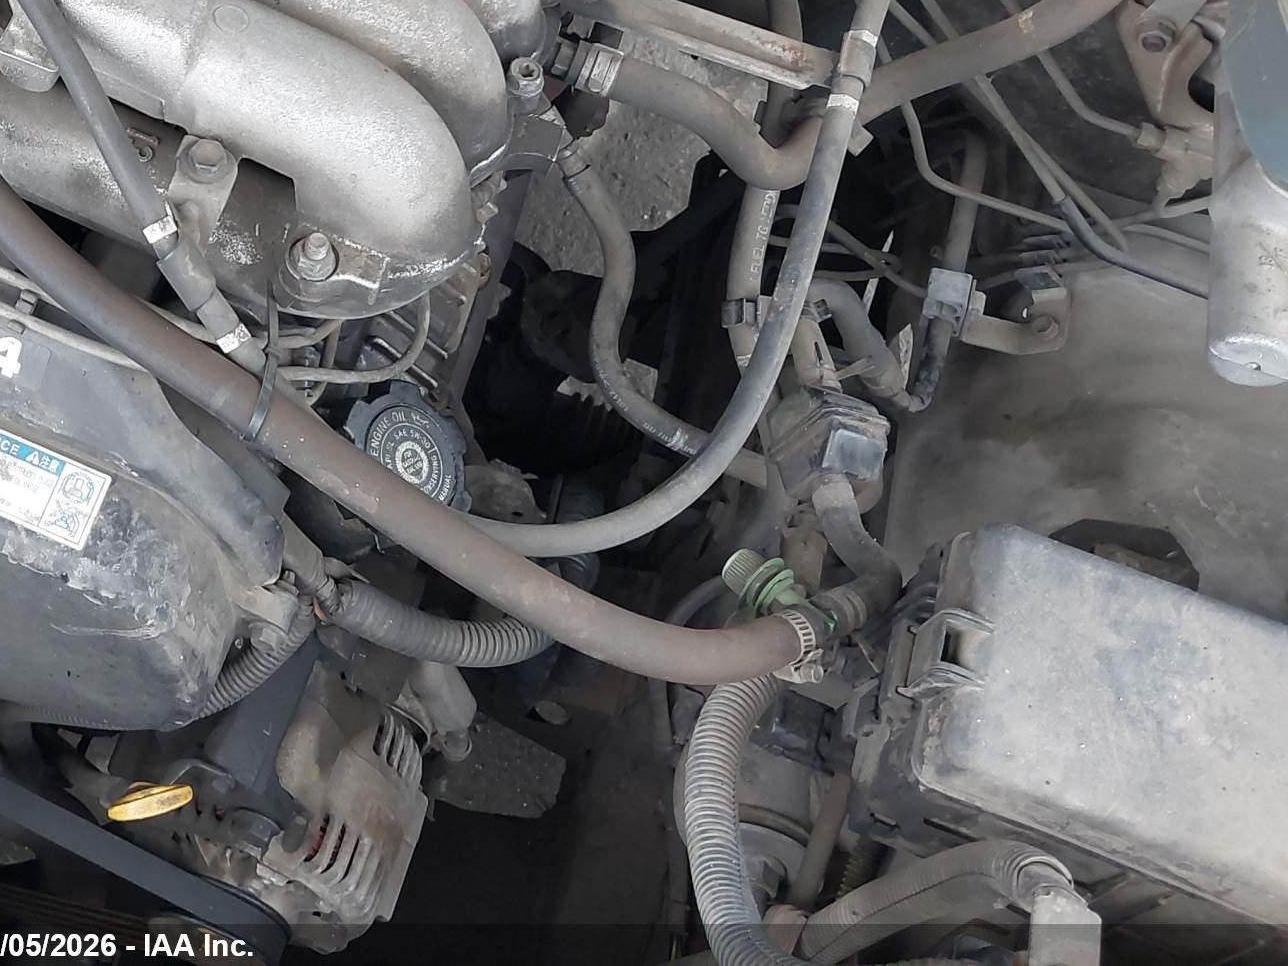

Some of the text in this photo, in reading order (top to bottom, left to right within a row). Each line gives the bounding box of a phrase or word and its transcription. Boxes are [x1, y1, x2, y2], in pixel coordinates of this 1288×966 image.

[370, 411, 407, 457] ENGINE OIL
[393, 428, 409, 441] SAE
[438, 474, 452, 502] MANUAL
